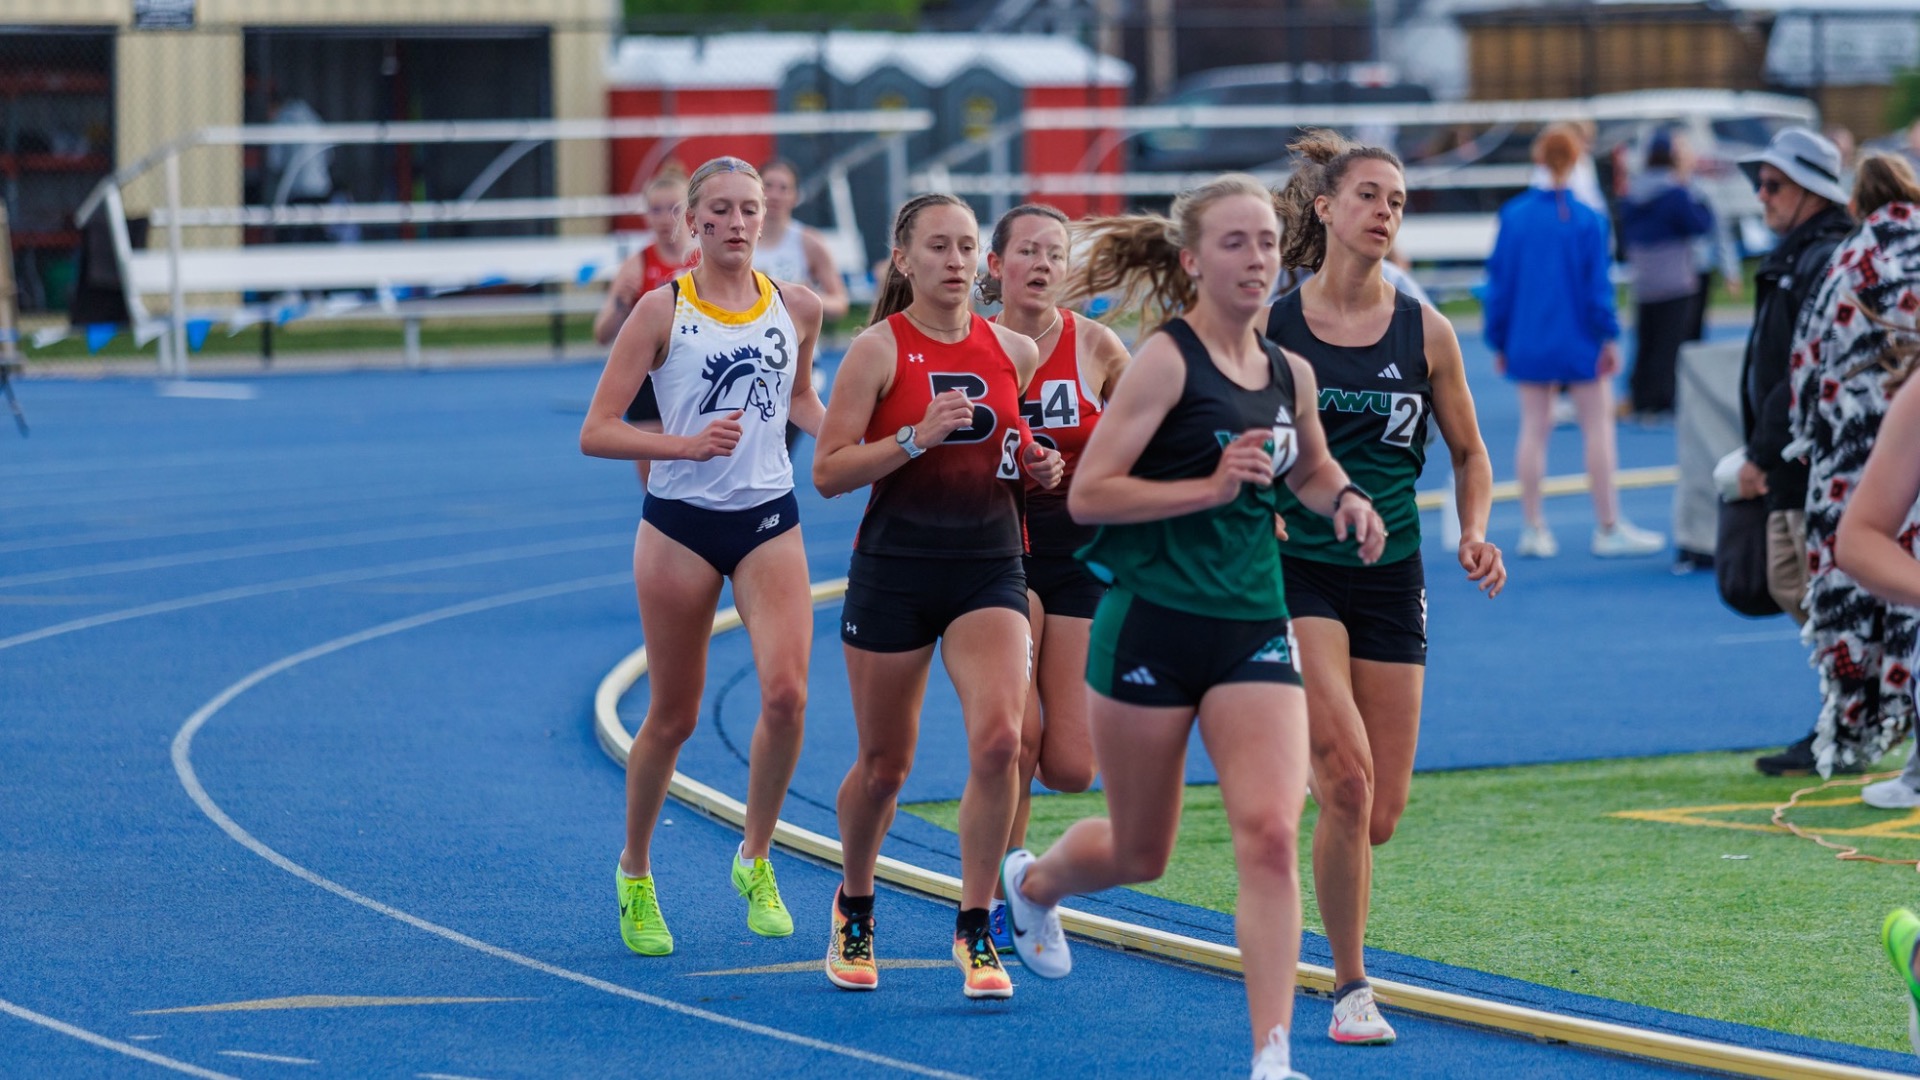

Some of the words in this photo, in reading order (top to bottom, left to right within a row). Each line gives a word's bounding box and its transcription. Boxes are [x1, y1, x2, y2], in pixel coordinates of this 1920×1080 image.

[764, 327, 789, 370] 3
[928, 372, 997, 445] B
[1044, 383, 1075, 425] 4
[1384, 396, 1418, 444] 2
[1001, 432, 1020, 477] 5
